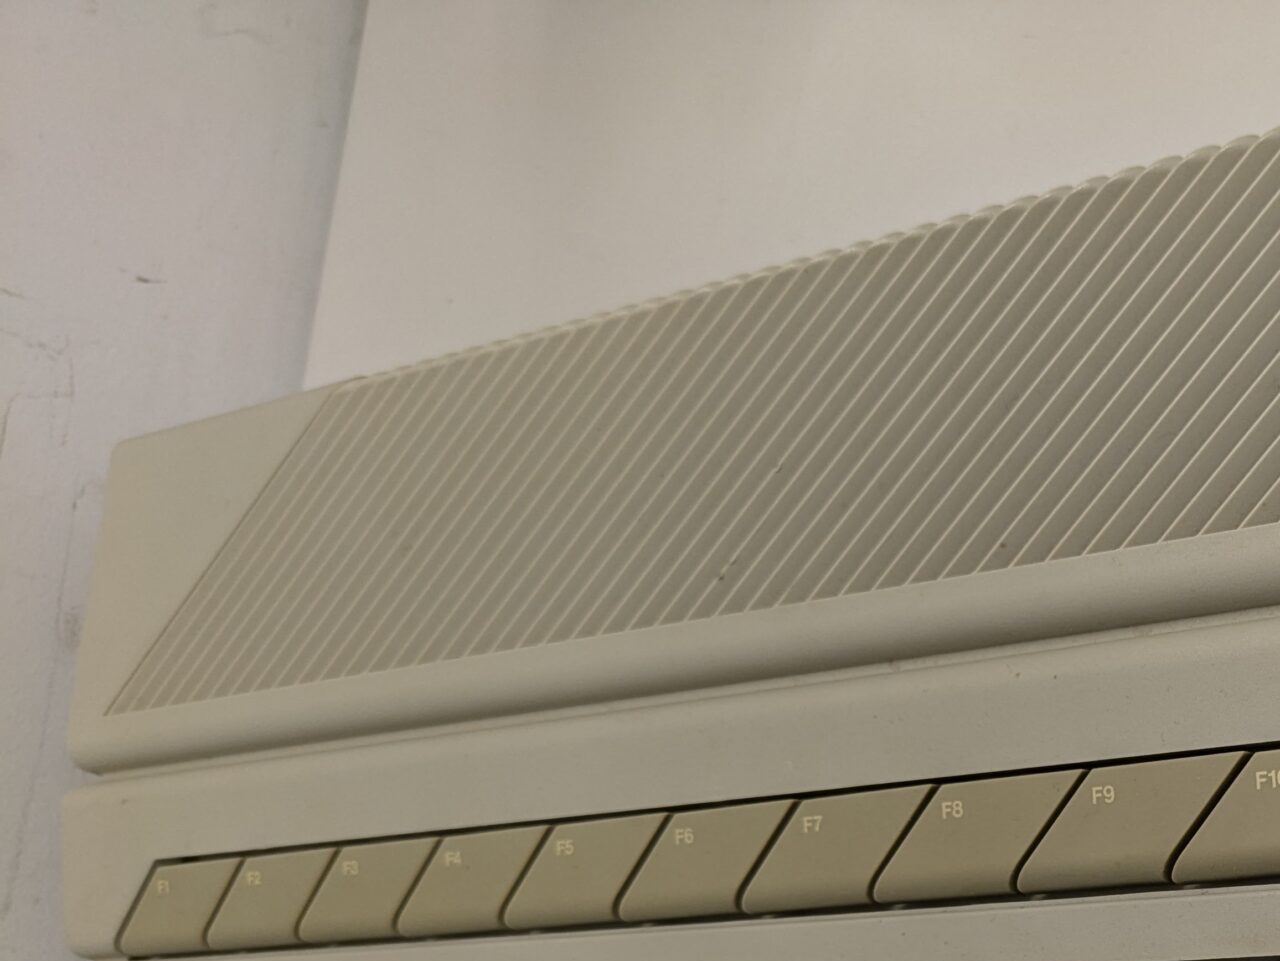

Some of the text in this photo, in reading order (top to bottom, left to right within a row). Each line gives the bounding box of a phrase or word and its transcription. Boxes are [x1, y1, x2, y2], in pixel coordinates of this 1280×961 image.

[1091, 785, 1115, 805] F9
[941, 800, 964, 820] F8
[802, 815, 823, 833] F7
[674, 827, 694, 845] F6
[555, 839, 574, 856] F5
[443, 850, 462, 867] F4
[341, 859, 359, 876] F3
[156, 879, 170, 894] F1
[245, 870, 262, 886] F2
